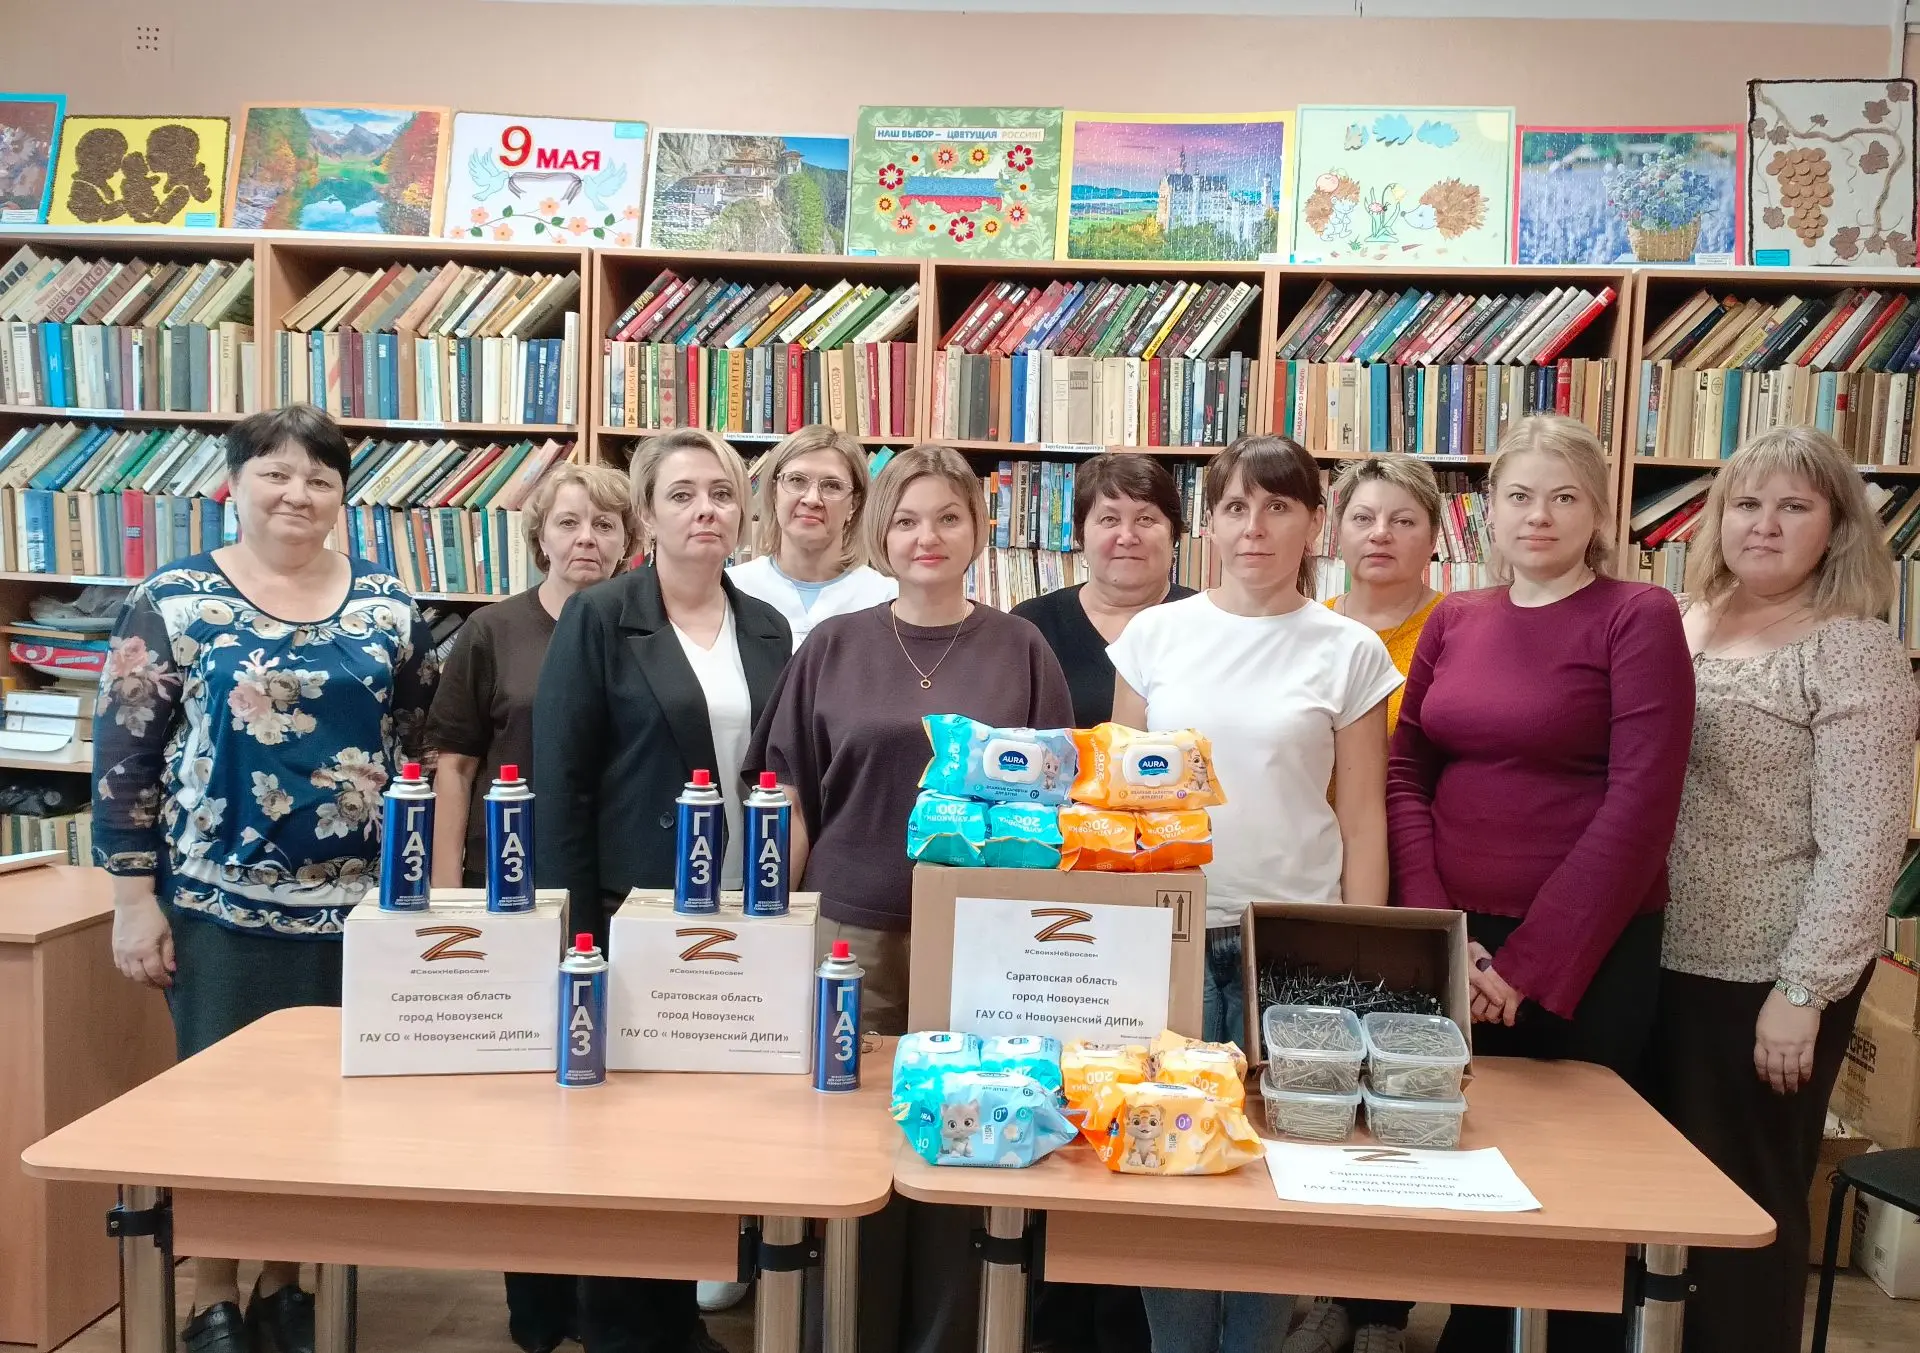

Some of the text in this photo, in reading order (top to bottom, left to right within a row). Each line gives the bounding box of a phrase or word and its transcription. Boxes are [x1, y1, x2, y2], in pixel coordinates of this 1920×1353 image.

[877, 130, 900, 138] НАШ
[901, 130, 934, 138] ВЫБОР
[947, 130, 998, 140] ЦВЕТУЩАЯ
[499, 125, 601, 171] 9 МАЯ
[729, 352, 741, 418] СЕРВАНТЕС
[1002, 754, 1025, 765] AURA
[1142, 760, 1165, 768] AURA
[402, 806, 425, 882] ГАЗ
[501, 806, 525, 882] ГАЗ
[690, 811, 713, 885] ГАЗ
[758, 814, 782, 888] ГАЗ
[1024, 949, 1099, 958] #СвоихНеБросаем
[669, 968, 744, 976] #СвоихНеБросаем
[1006, 971, 1118, 987] Саратовская область
[391, 991, 512, 1003] Саратовская область
[651, 990, 763, 1003] Саратовская область
[1012, 991, 1110, 1006] город Новоузенск
[399, 1011, 503, 1023] город Новоузенск
[569, 980, 593, 1057] ГАЗ
[657, 1011, 755, 1022] город Новоузенск
[832, 985, 856, 1062] ГАЗ
[975, 1009, 996, 1019] ГАУ
[998, 1010, 1013, 1020] СО
[1025, 1012, 1102, 1026] Новоузенский
[359, 1033, 381, 1042] ГАУ
[384, 1032, 400, 1042] СО
[414, 1031, 496, 1043] Новоузенский
[620, 1028, 641, 1038] ГАУ
[643, 1029, 658, 1038] СО
[671, 1029, 748, 1041] Новоузенский
